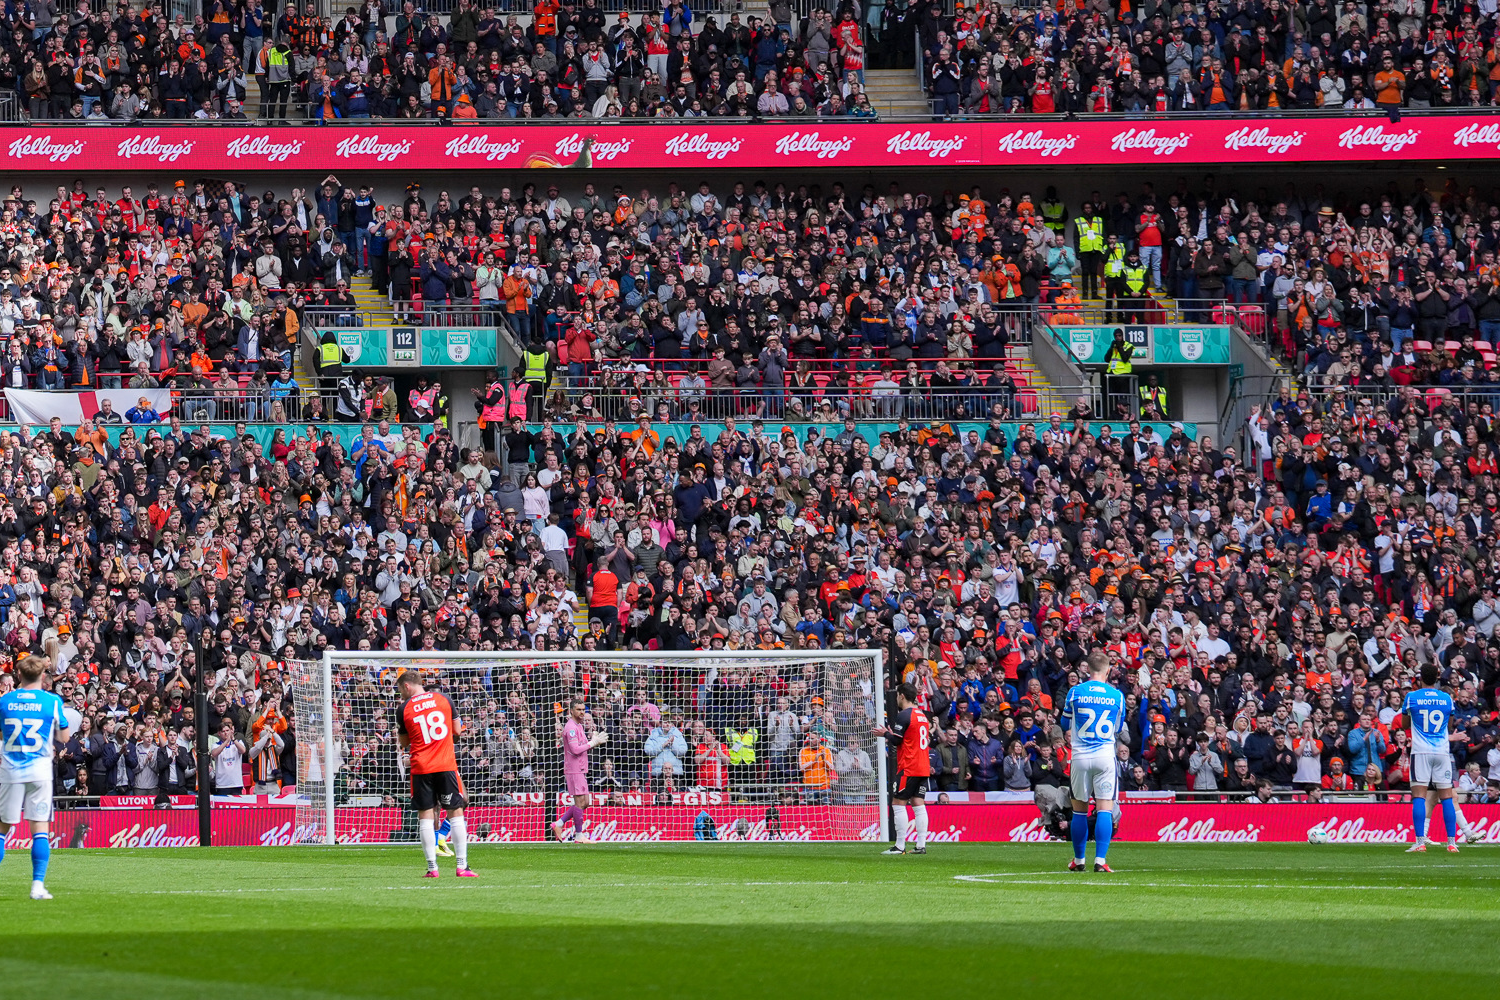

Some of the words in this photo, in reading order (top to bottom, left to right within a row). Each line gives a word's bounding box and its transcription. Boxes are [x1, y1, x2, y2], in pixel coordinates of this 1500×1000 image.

[9, 135, 83, 161] Kellogg's
[118, 135, 192, 161] Kellogg's
[227, 135, 302, 161] Kellogg's
[336, 135, 411, 161] Kellogg's
[445, 134, 520, 161] Kellogg's
[665, 133, 740, 159] Kellogg's
[776, 132, 852, 158] Kellogg's
[887, 131, 963, 157] Kellogg's
[999, 130, 1076, 156] Kellogg's
[1112, 129, 1189, 155] Kellogg's
[1225, 127, 1302, 153] Kellogg's
[1339, 125, 1417, 151] Kellogg's
[396, 333, 412, 345] 112
[1128, 330, 1145, 343] 113
[8, 703, 42, 712] OSBORN
[413, 700, 436, 713] CLARK
[1078, 696, 1116, 705] NORWOOD
[413, 710, 448, 744] 18
[1077, 707, 1114, 739] 26
[1419, 709, 1444, 733] 19
[4, 718, 44, 752] 23
[919, 725, 929, 750] 8
[118, 797, 148, 805] LUTON
